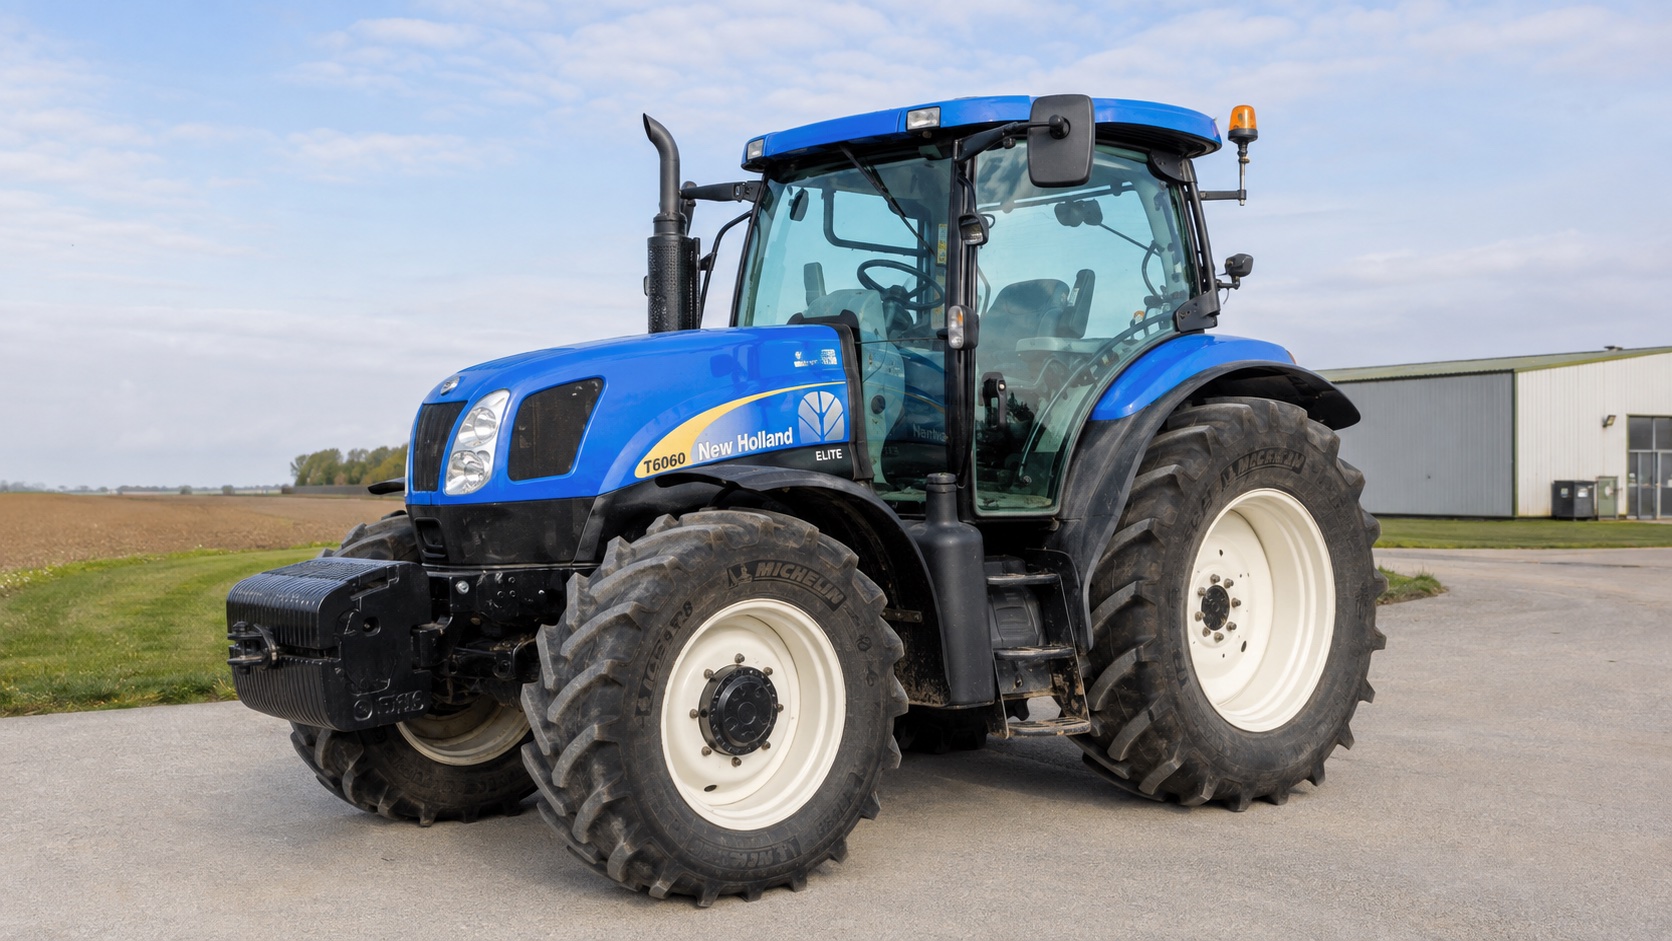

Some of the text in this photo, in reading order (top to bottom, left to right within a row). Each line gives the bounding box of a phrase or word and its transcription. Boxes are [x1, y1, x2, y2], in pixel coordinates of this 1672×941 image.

[698, 427, 794, 461] New Holland
[816, 449, 843, 461] ELITE
[643, 452, 686, 474] T6060
[755, 561, 845, 605] MICHELIN
